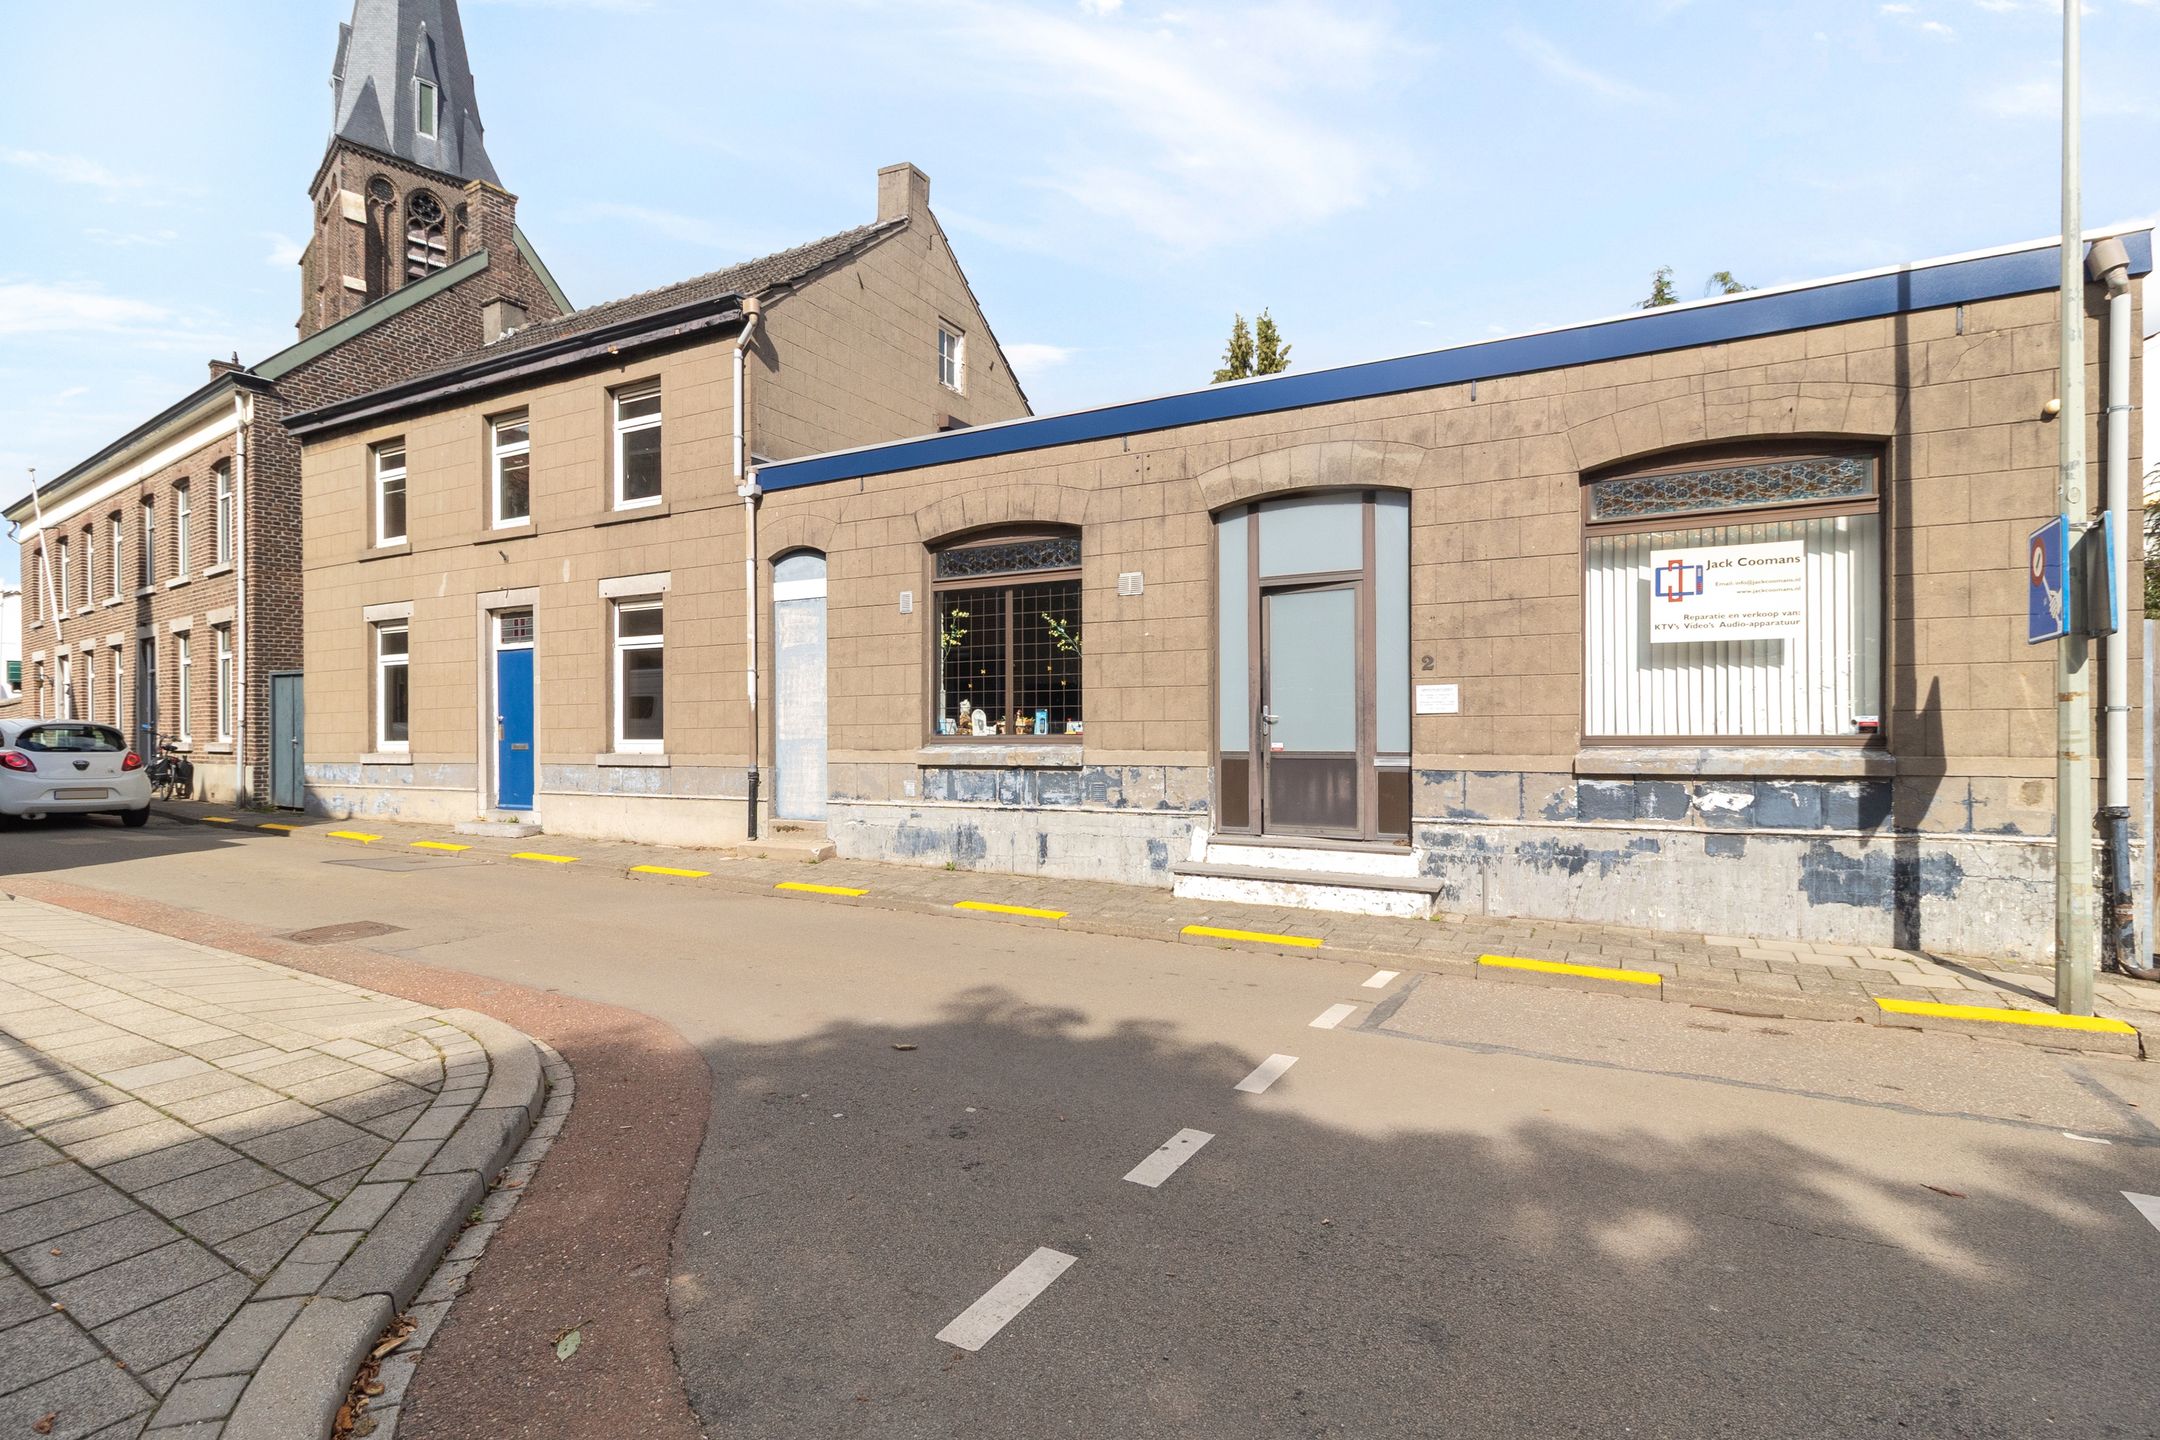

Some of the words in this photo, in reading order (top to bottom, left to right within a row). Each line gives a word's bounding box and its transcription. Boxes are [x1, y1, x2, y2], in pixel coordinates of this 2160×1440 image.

[1706, 559, 1733, 571] Jack
[1737, 556, 1801, 567] Coomans
[1683, 613, 1726, 621] Reparatie
[1683, 621, 1715, 629] Video's
[1719, 619, 1801, 628] Audio-apparatuur
[1421, 654, 1435, 671] 2
